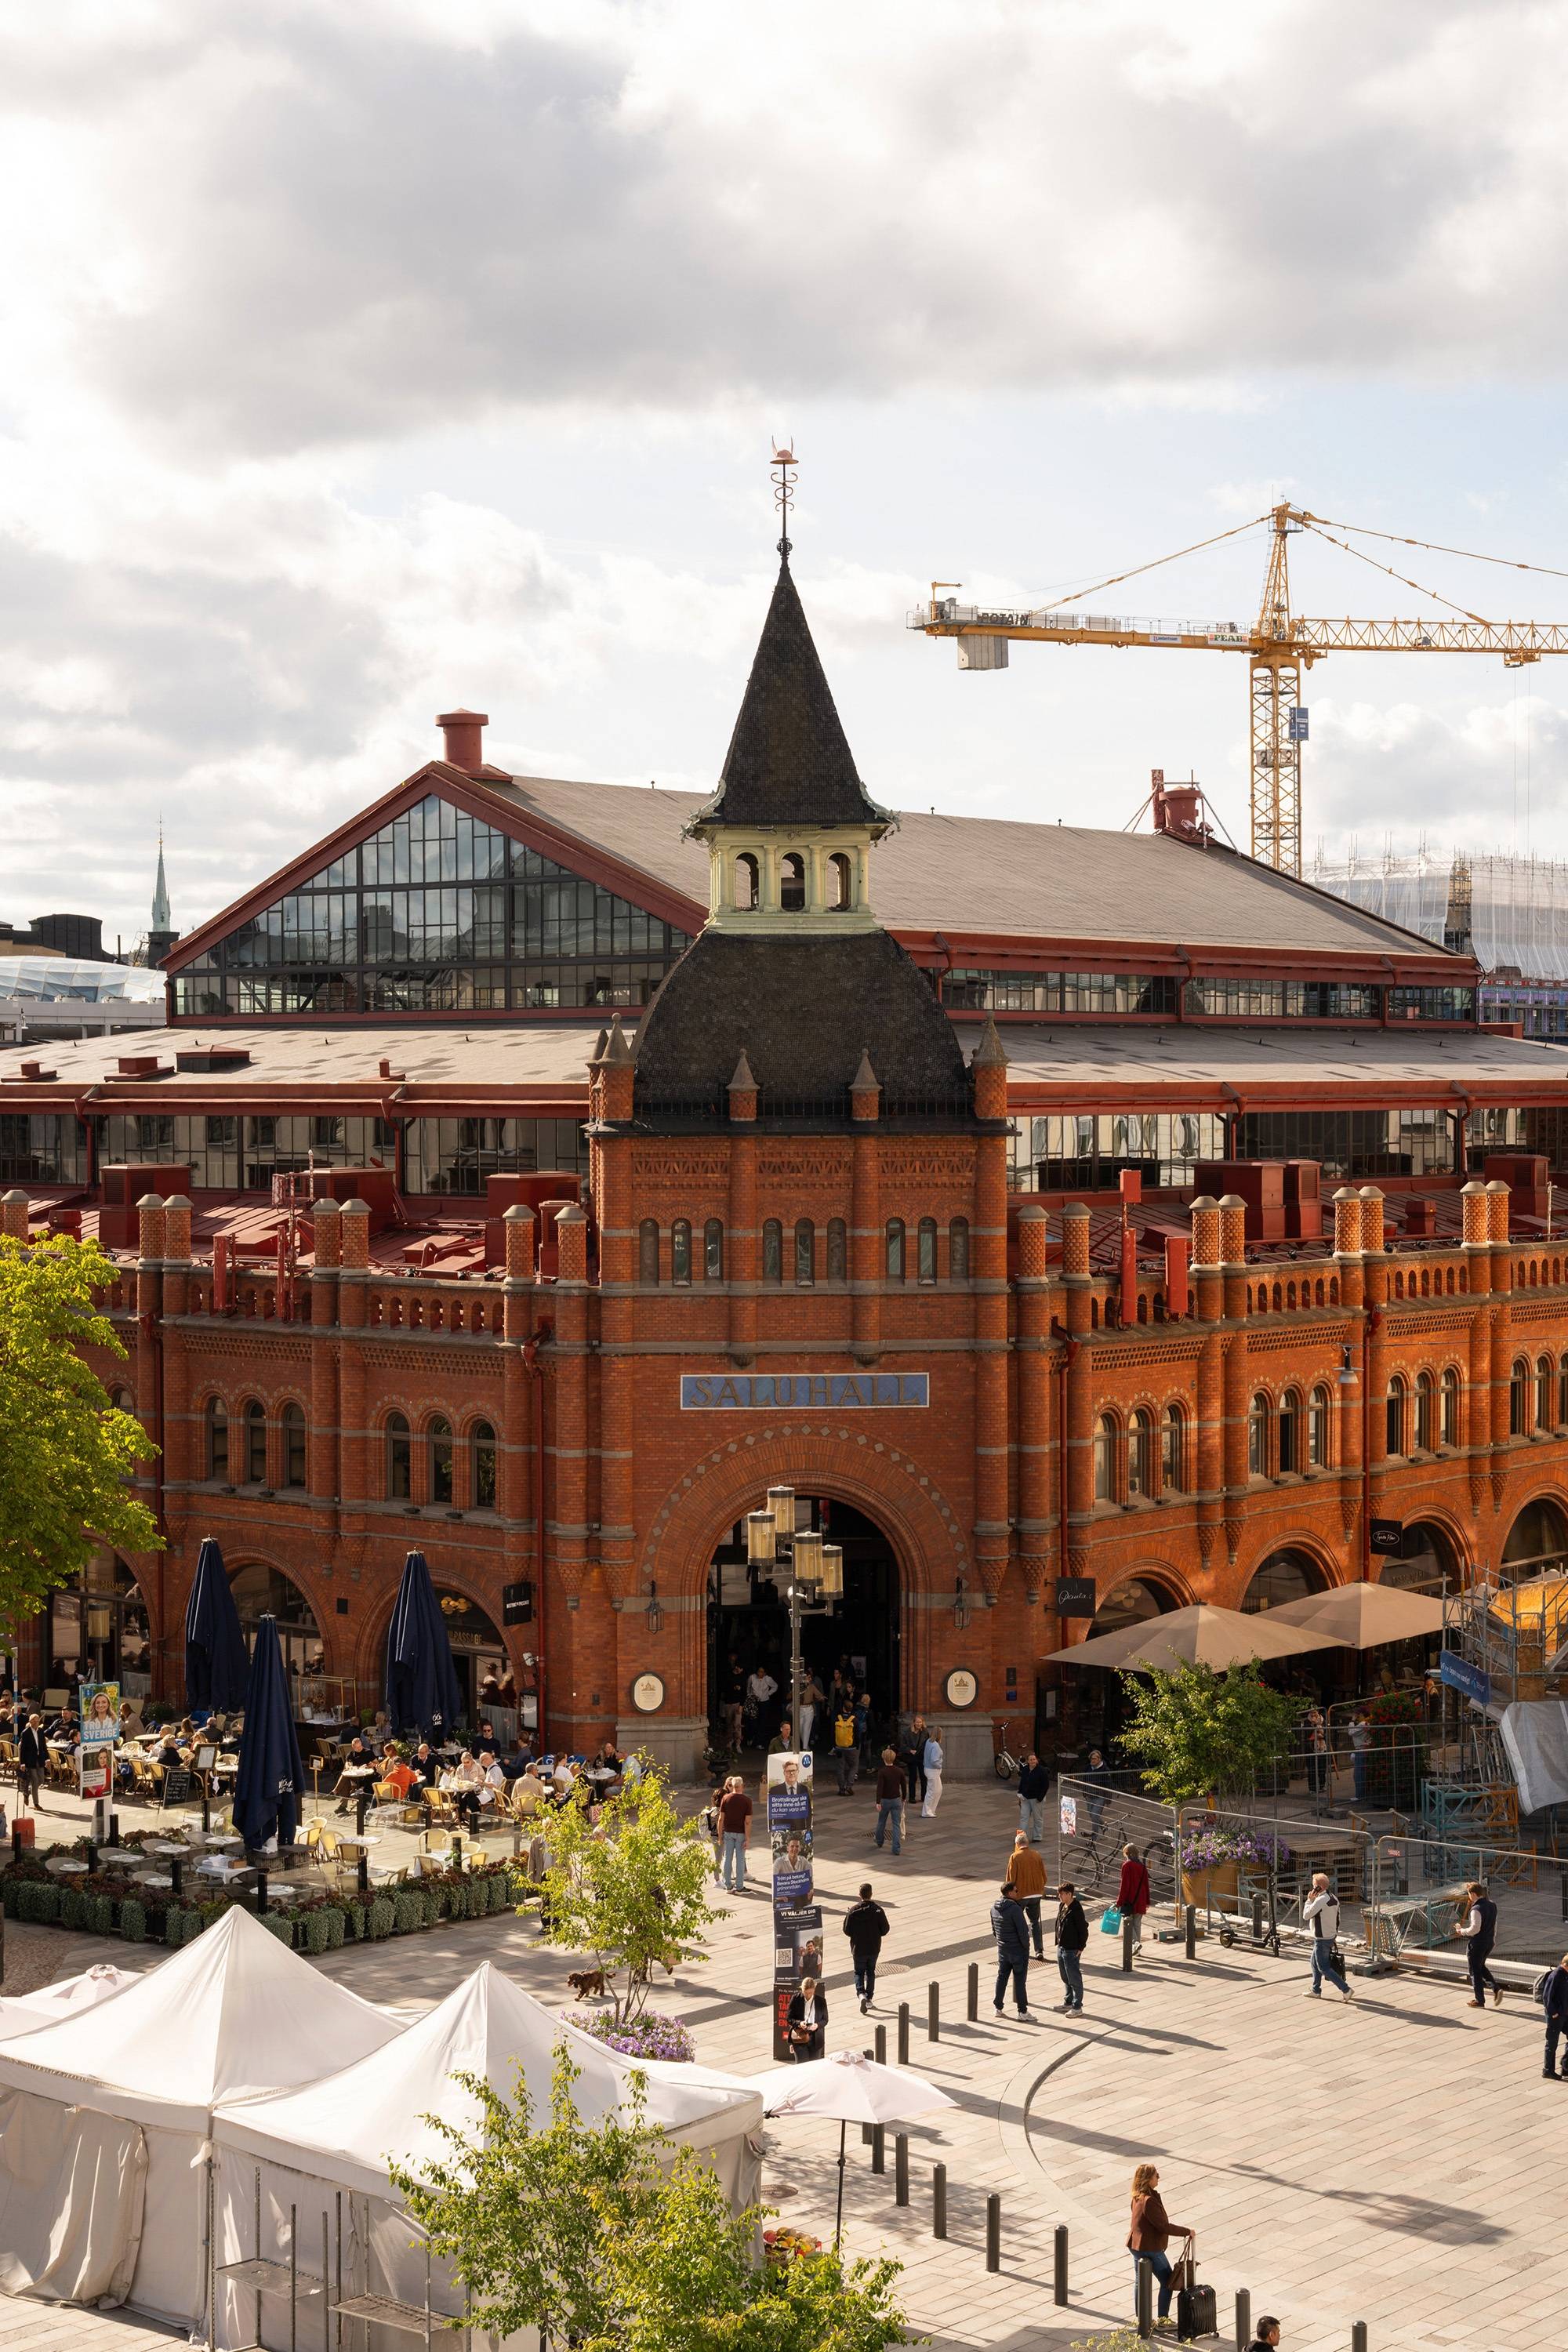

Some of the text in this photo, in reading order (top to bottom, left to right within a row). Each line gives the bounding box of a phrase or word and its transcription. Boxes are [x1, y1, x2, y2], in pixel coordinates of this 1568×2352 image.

[1214, 634, 1243, 643] PEAB
[690, 1374, 920, 1406] SALUHALL
[83, 1721, 100, 1730] TRO
[83, 1728, 118, 1740] SVERIGE
